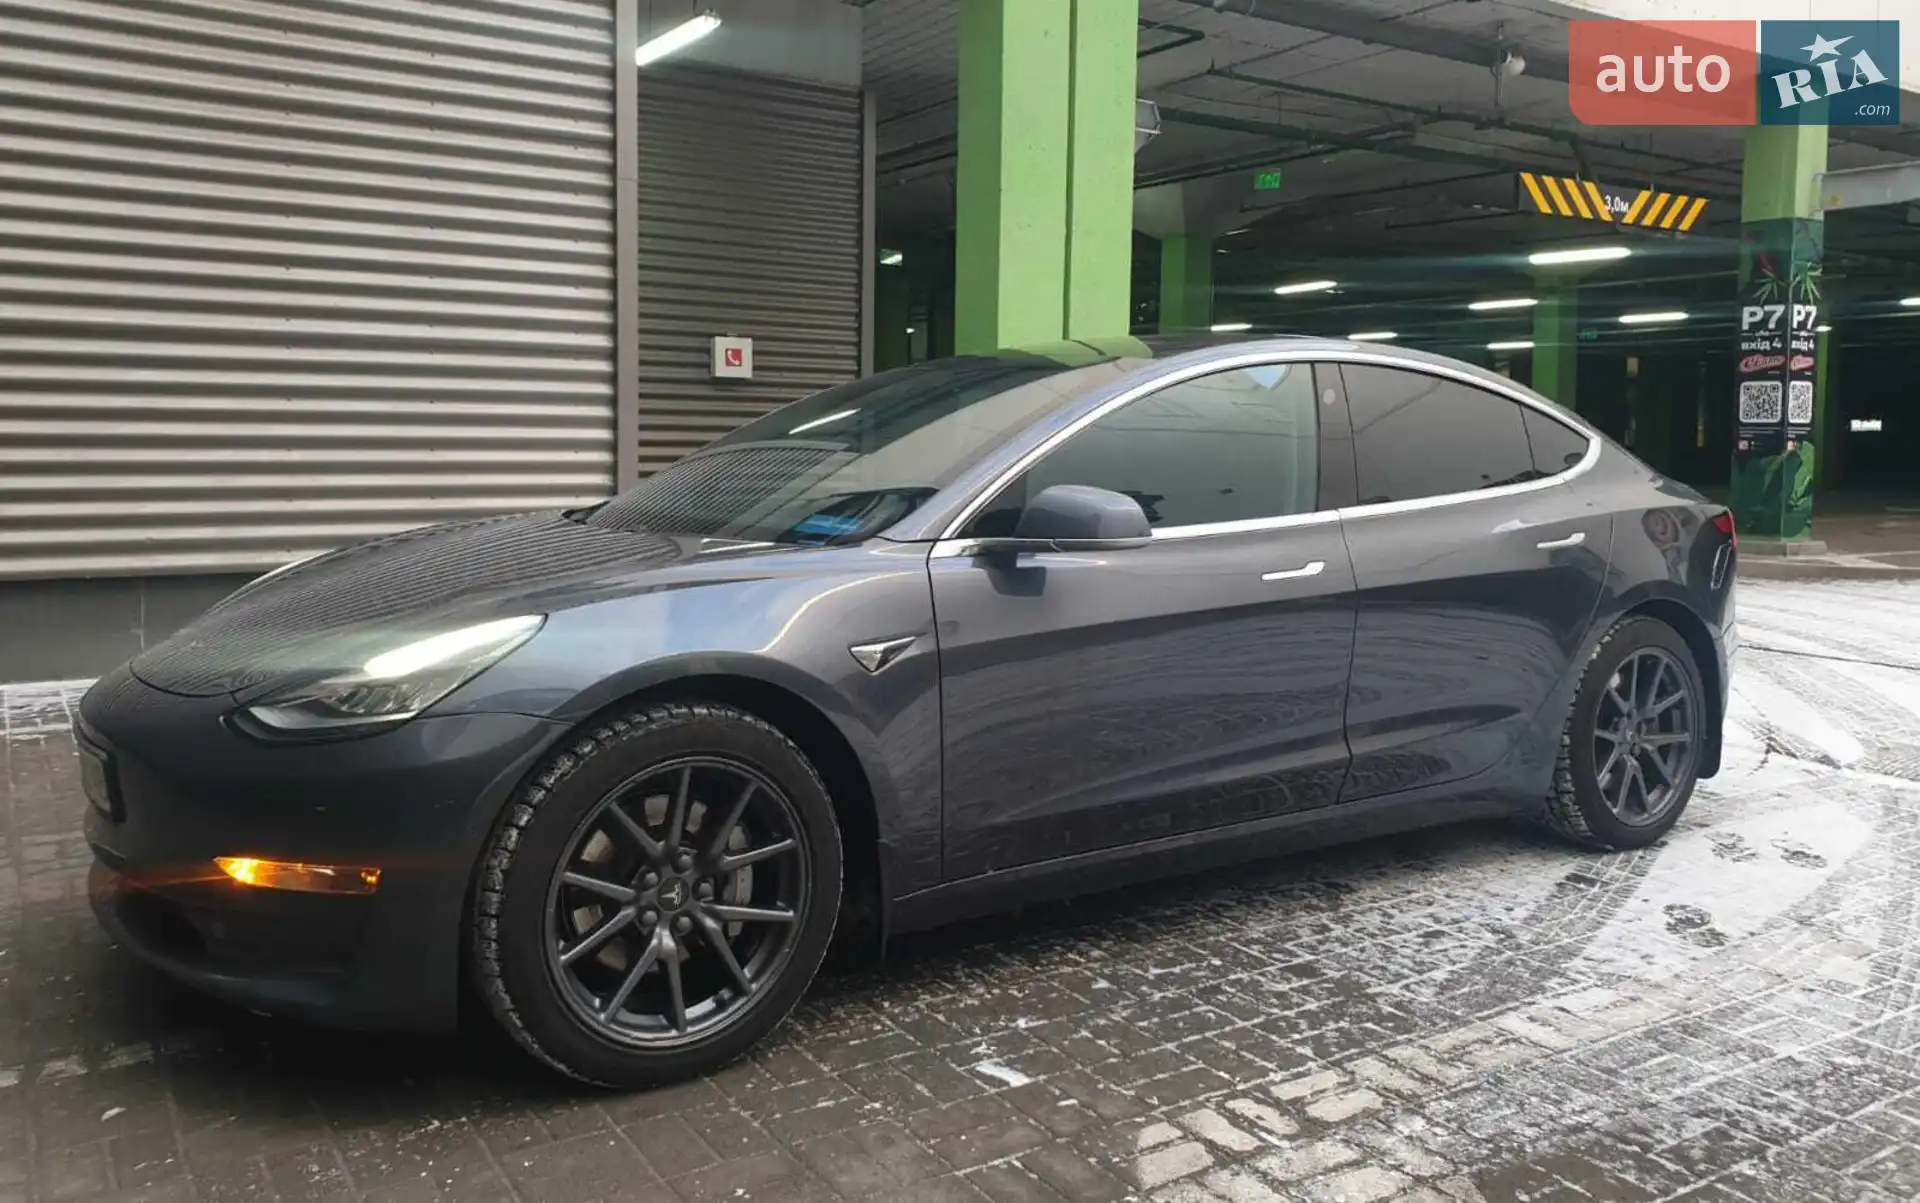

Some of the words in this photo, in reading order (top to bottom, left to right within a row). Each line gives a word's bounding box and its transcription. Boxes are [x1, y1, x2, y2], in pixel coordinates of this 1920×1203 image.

[1742, 304, 1786, 331] P7
[1792, 303, 1818, 330] P7
[1740, 338, 1771, 351] вхід
[1771, 337, 1783, 349] 4
